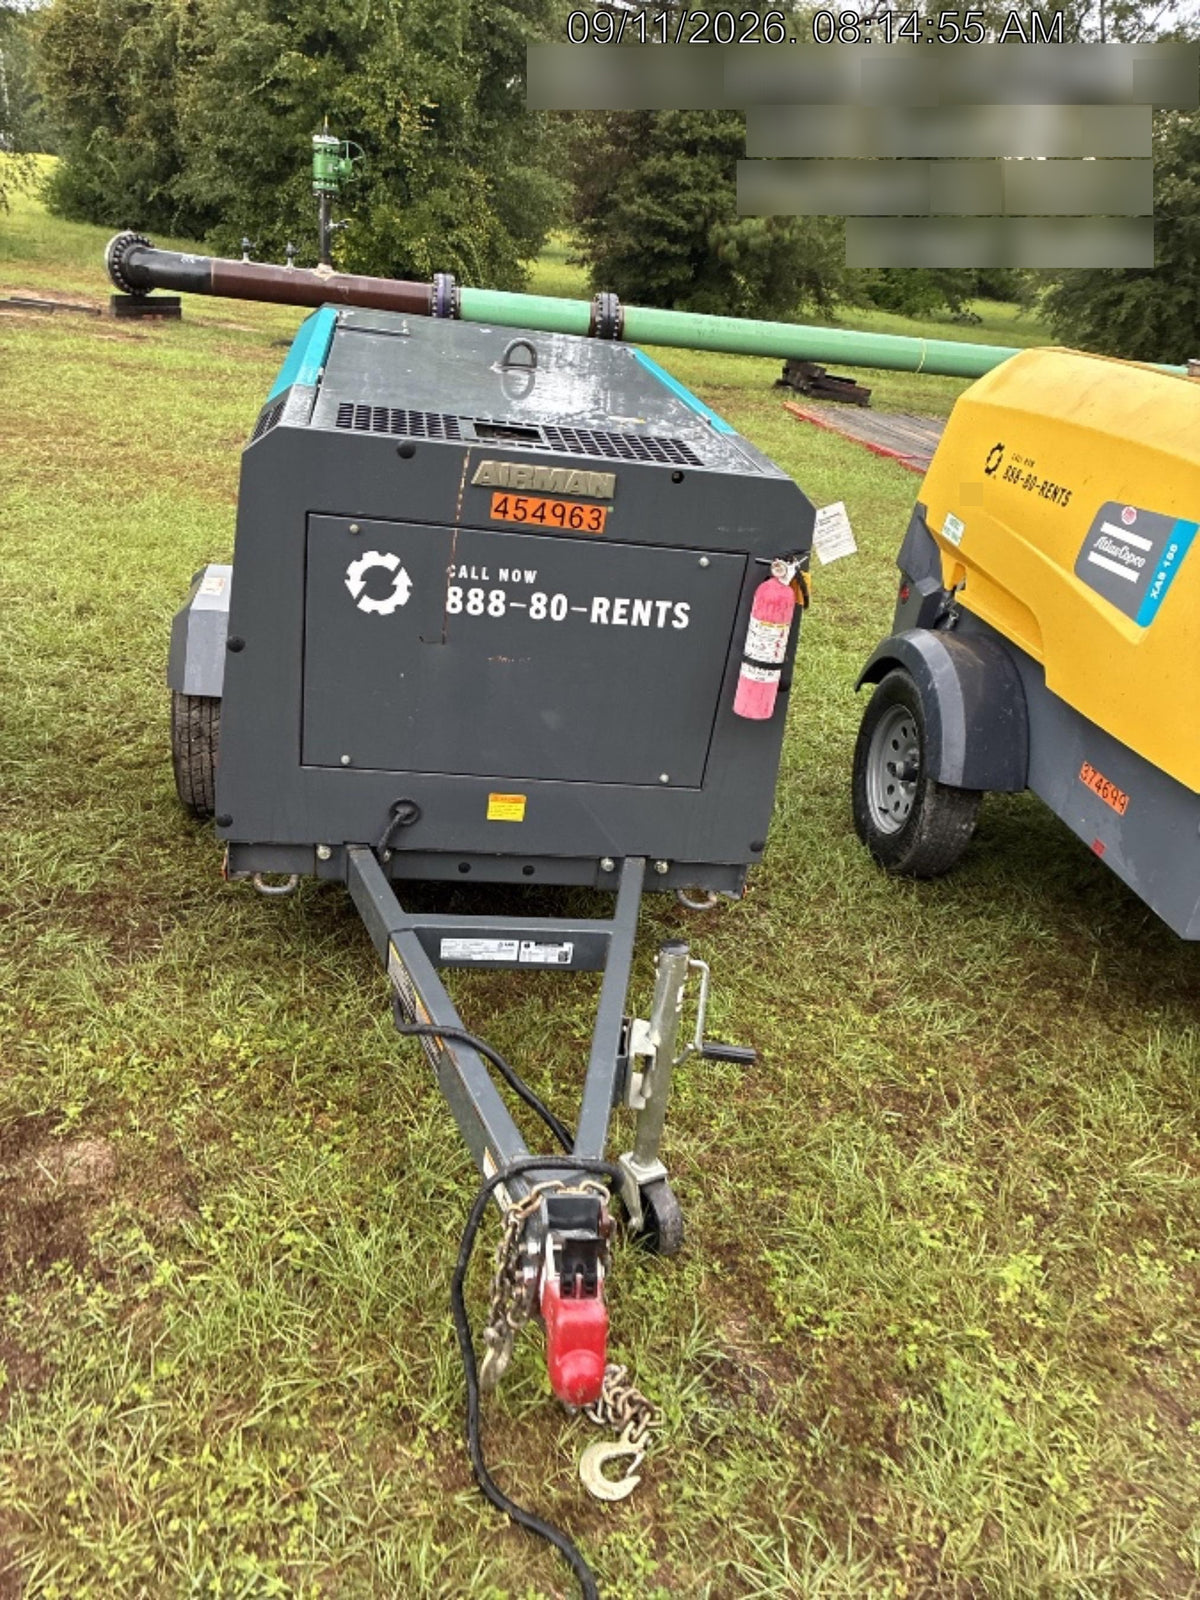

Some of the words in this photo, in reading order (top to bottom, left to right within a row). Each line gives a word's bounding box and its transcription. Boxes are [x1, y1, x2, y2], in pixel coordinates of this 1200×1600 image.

[471, 459, 617, 499] AIRMAN
[493, 496, 603, 531] 454963
[446, 564, 490, 581] CALL
[499, 568, 537, 584] NOW
[445, 586, 691, 629] 888-80-RENTS
[1080, 763, 1127, 813] 374699
